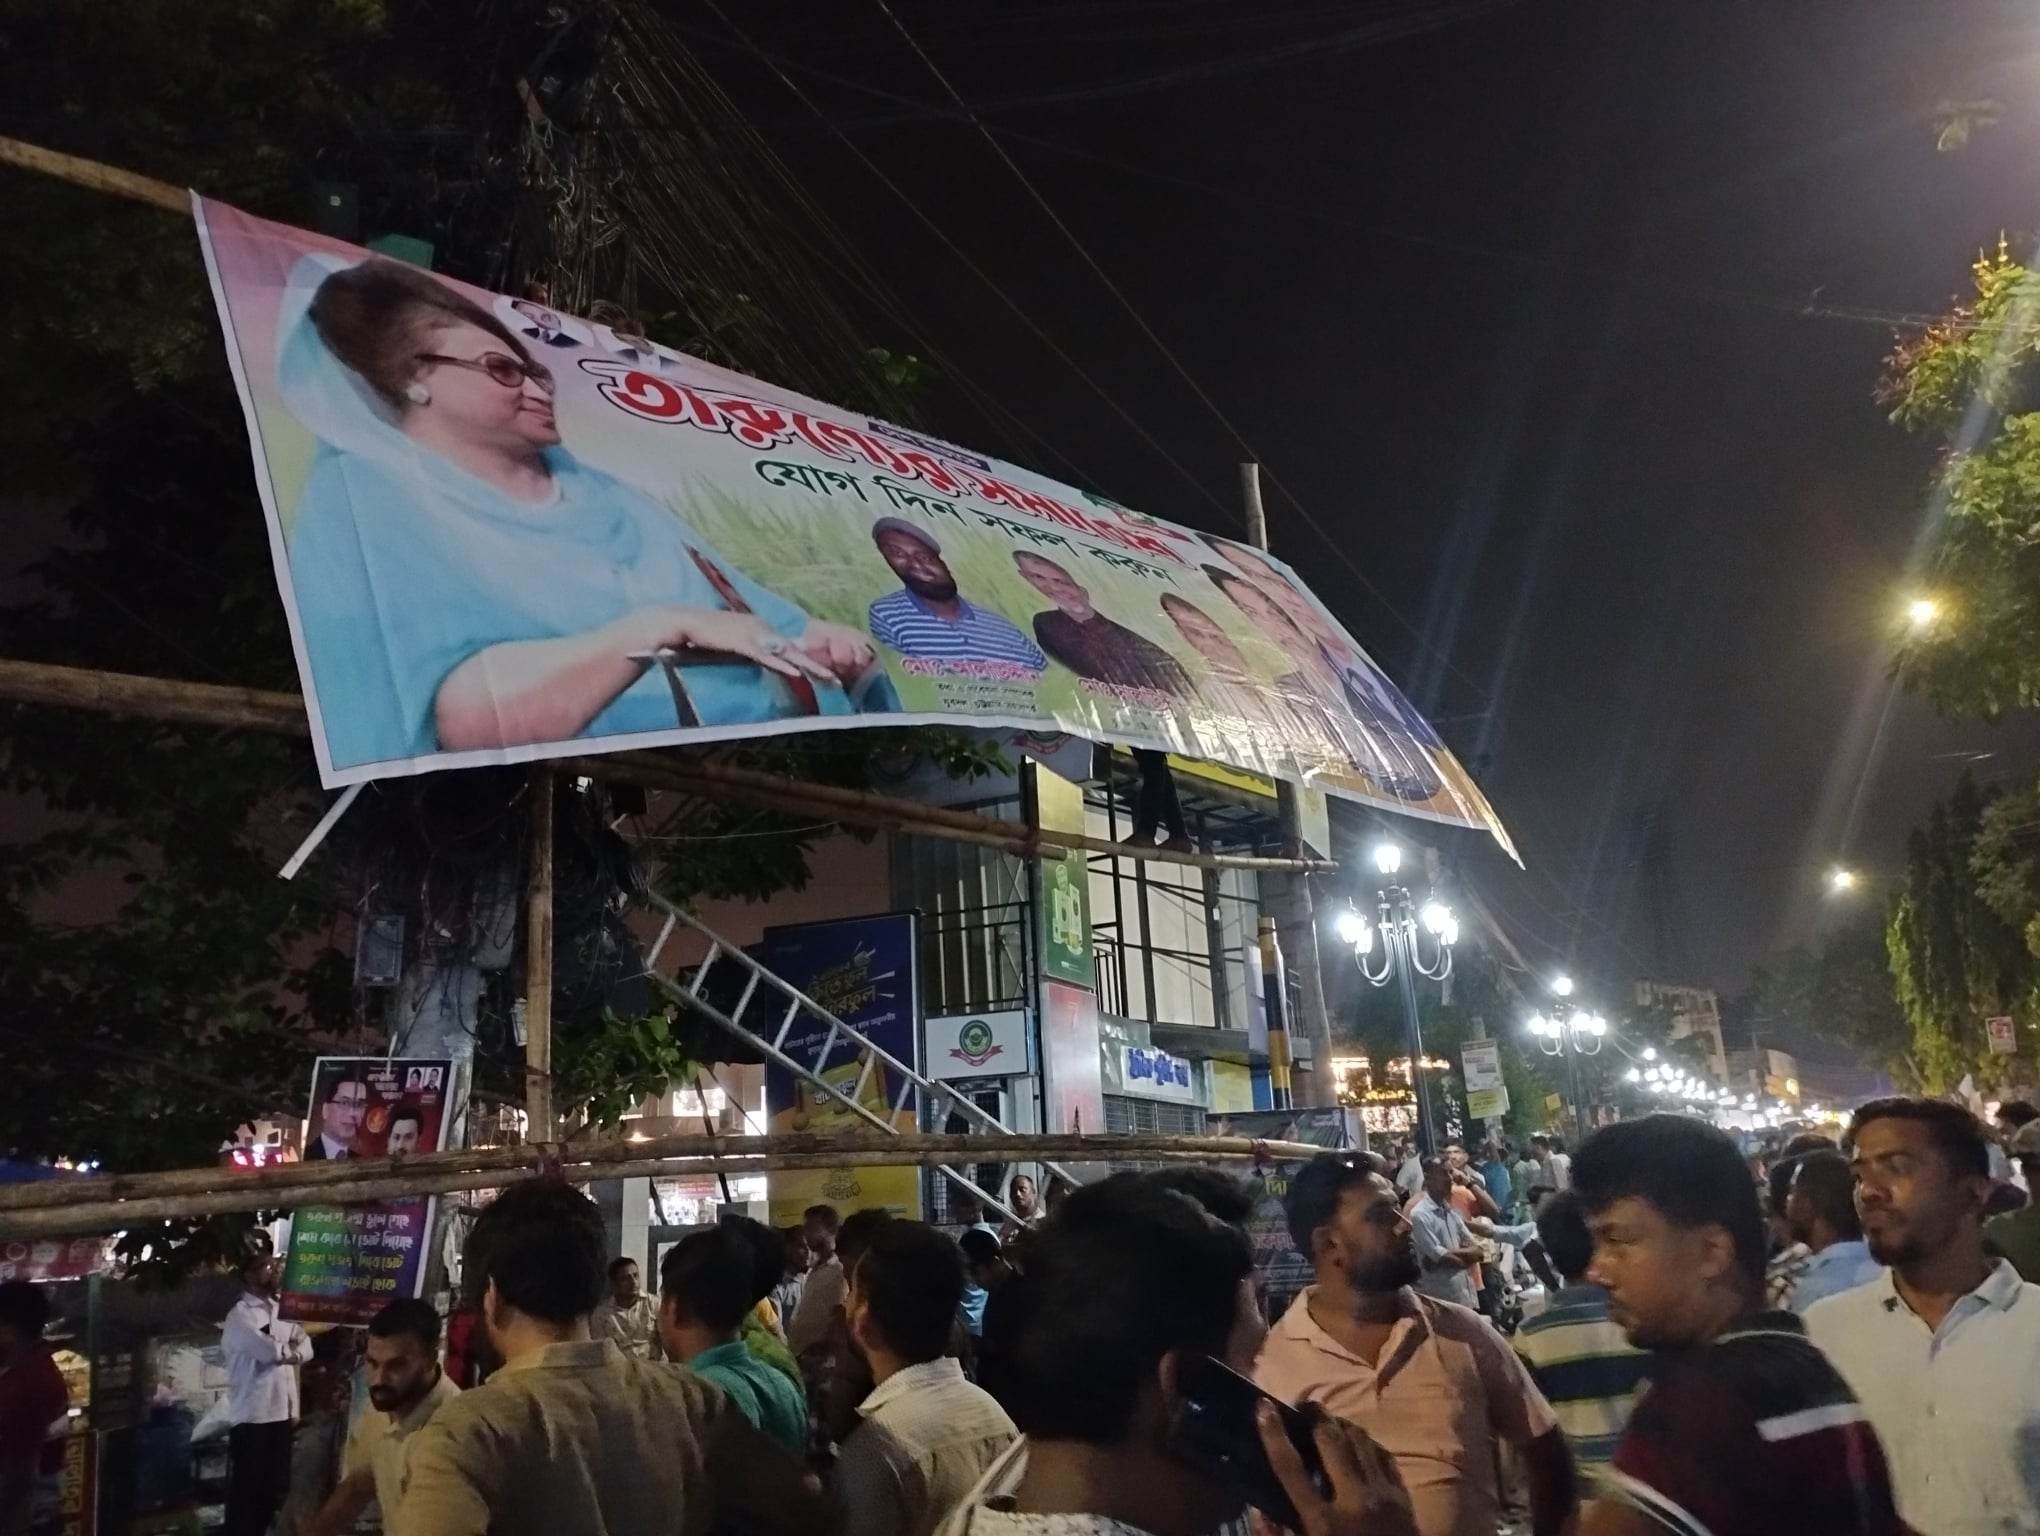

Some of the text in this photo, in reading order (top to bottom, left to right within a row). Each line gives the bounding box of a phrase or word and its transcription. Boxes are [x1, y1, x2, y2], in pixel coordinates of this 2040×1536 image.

[596, 366, 966, 494] তারুণ্যের
[756, 460, 1183, 590] যোগ দিন সফল করুন
